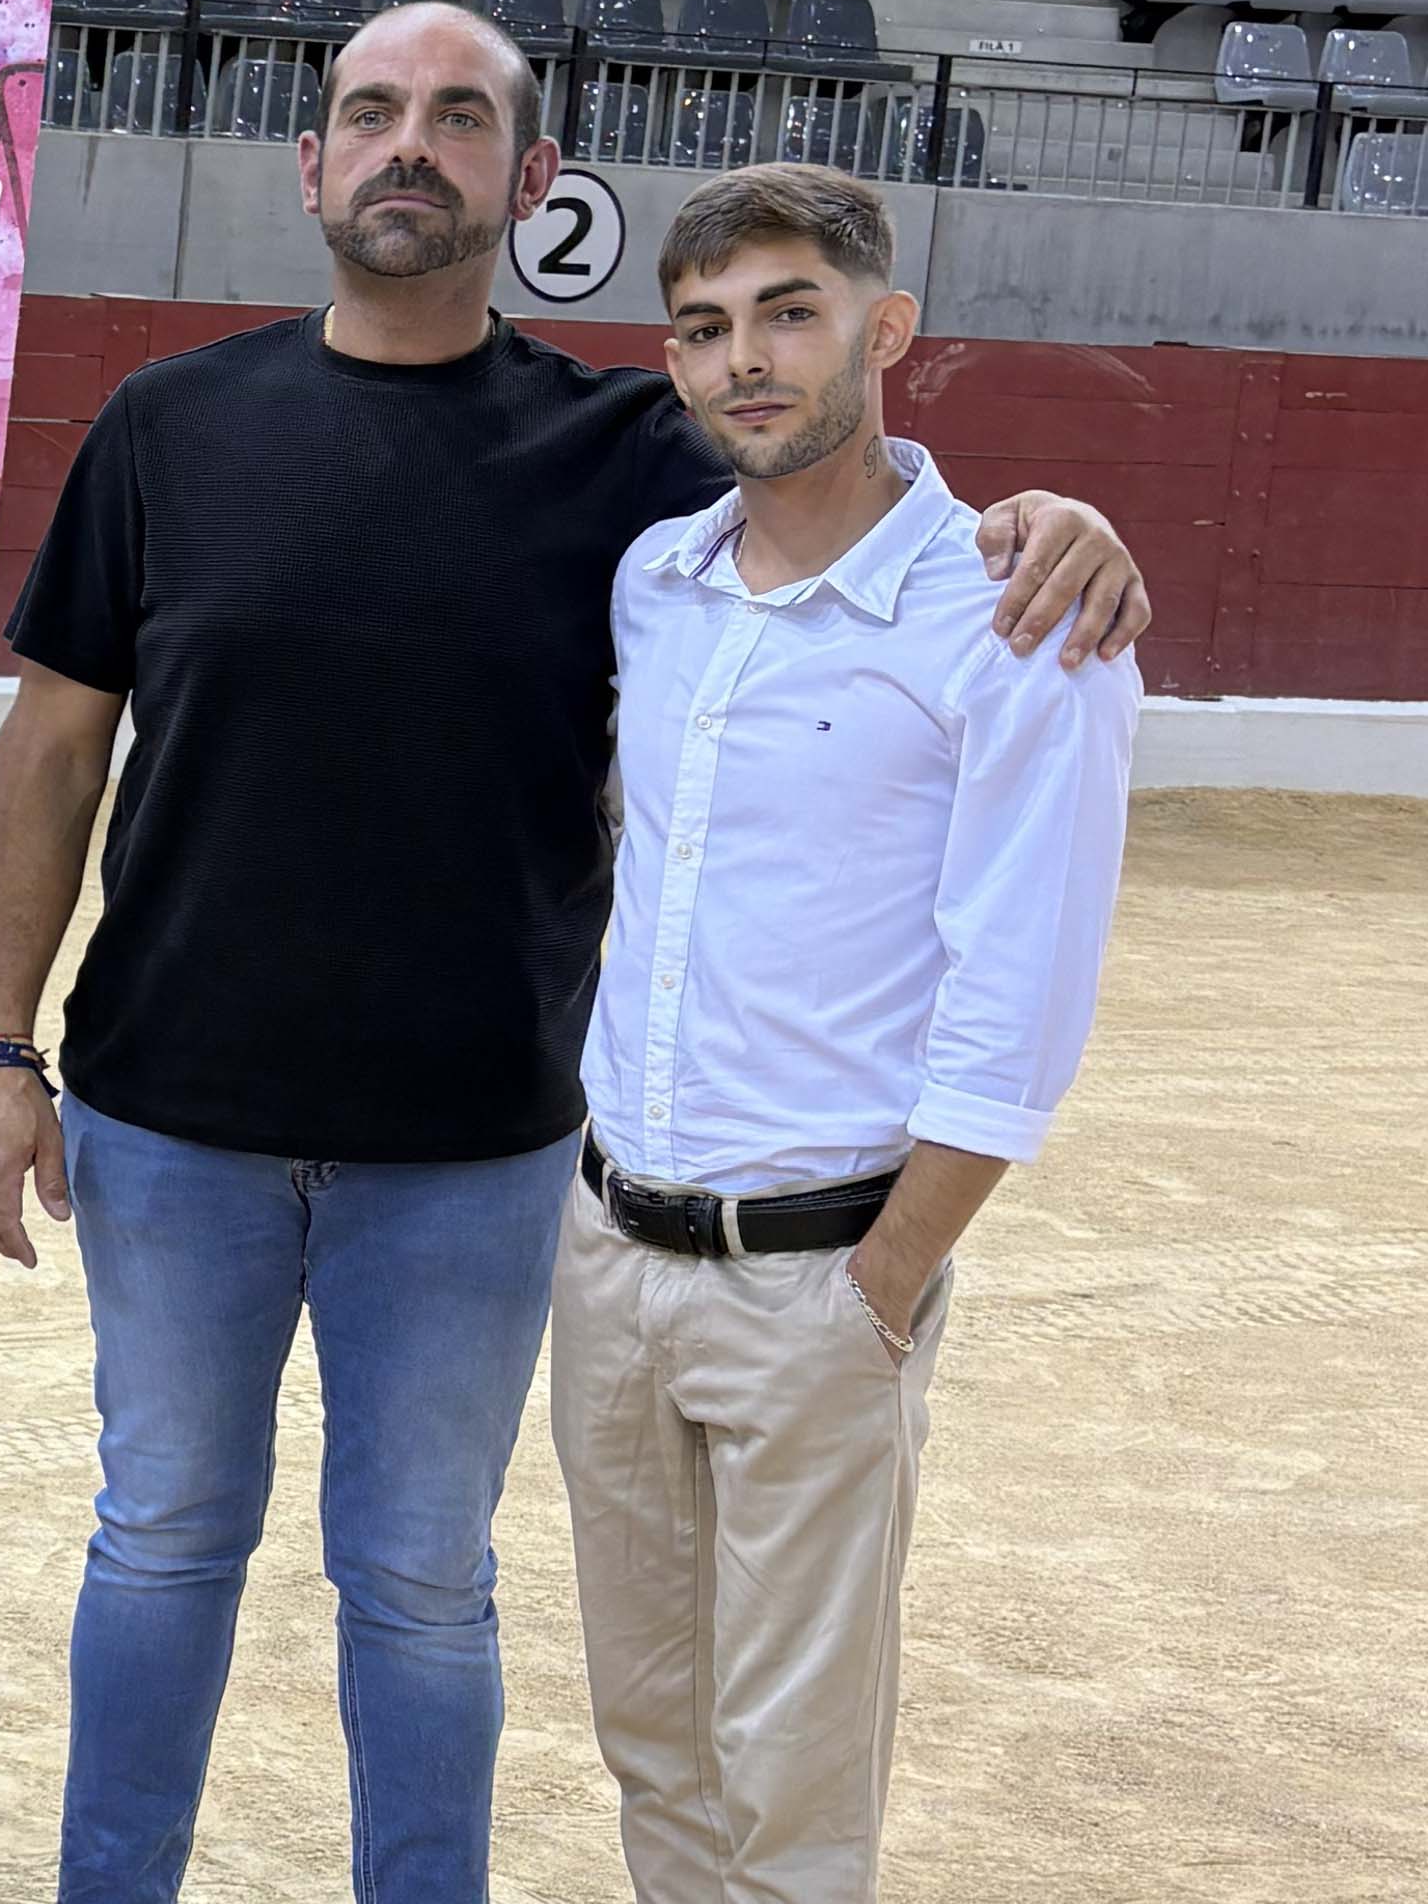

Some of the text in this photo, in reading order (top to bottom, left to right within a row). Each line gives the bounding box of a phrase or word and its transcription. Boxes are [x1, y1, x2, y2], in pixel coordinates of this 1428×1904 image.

[979, 42, 1013, 51] FILA 1
[538, 197, 592, 276] 2
